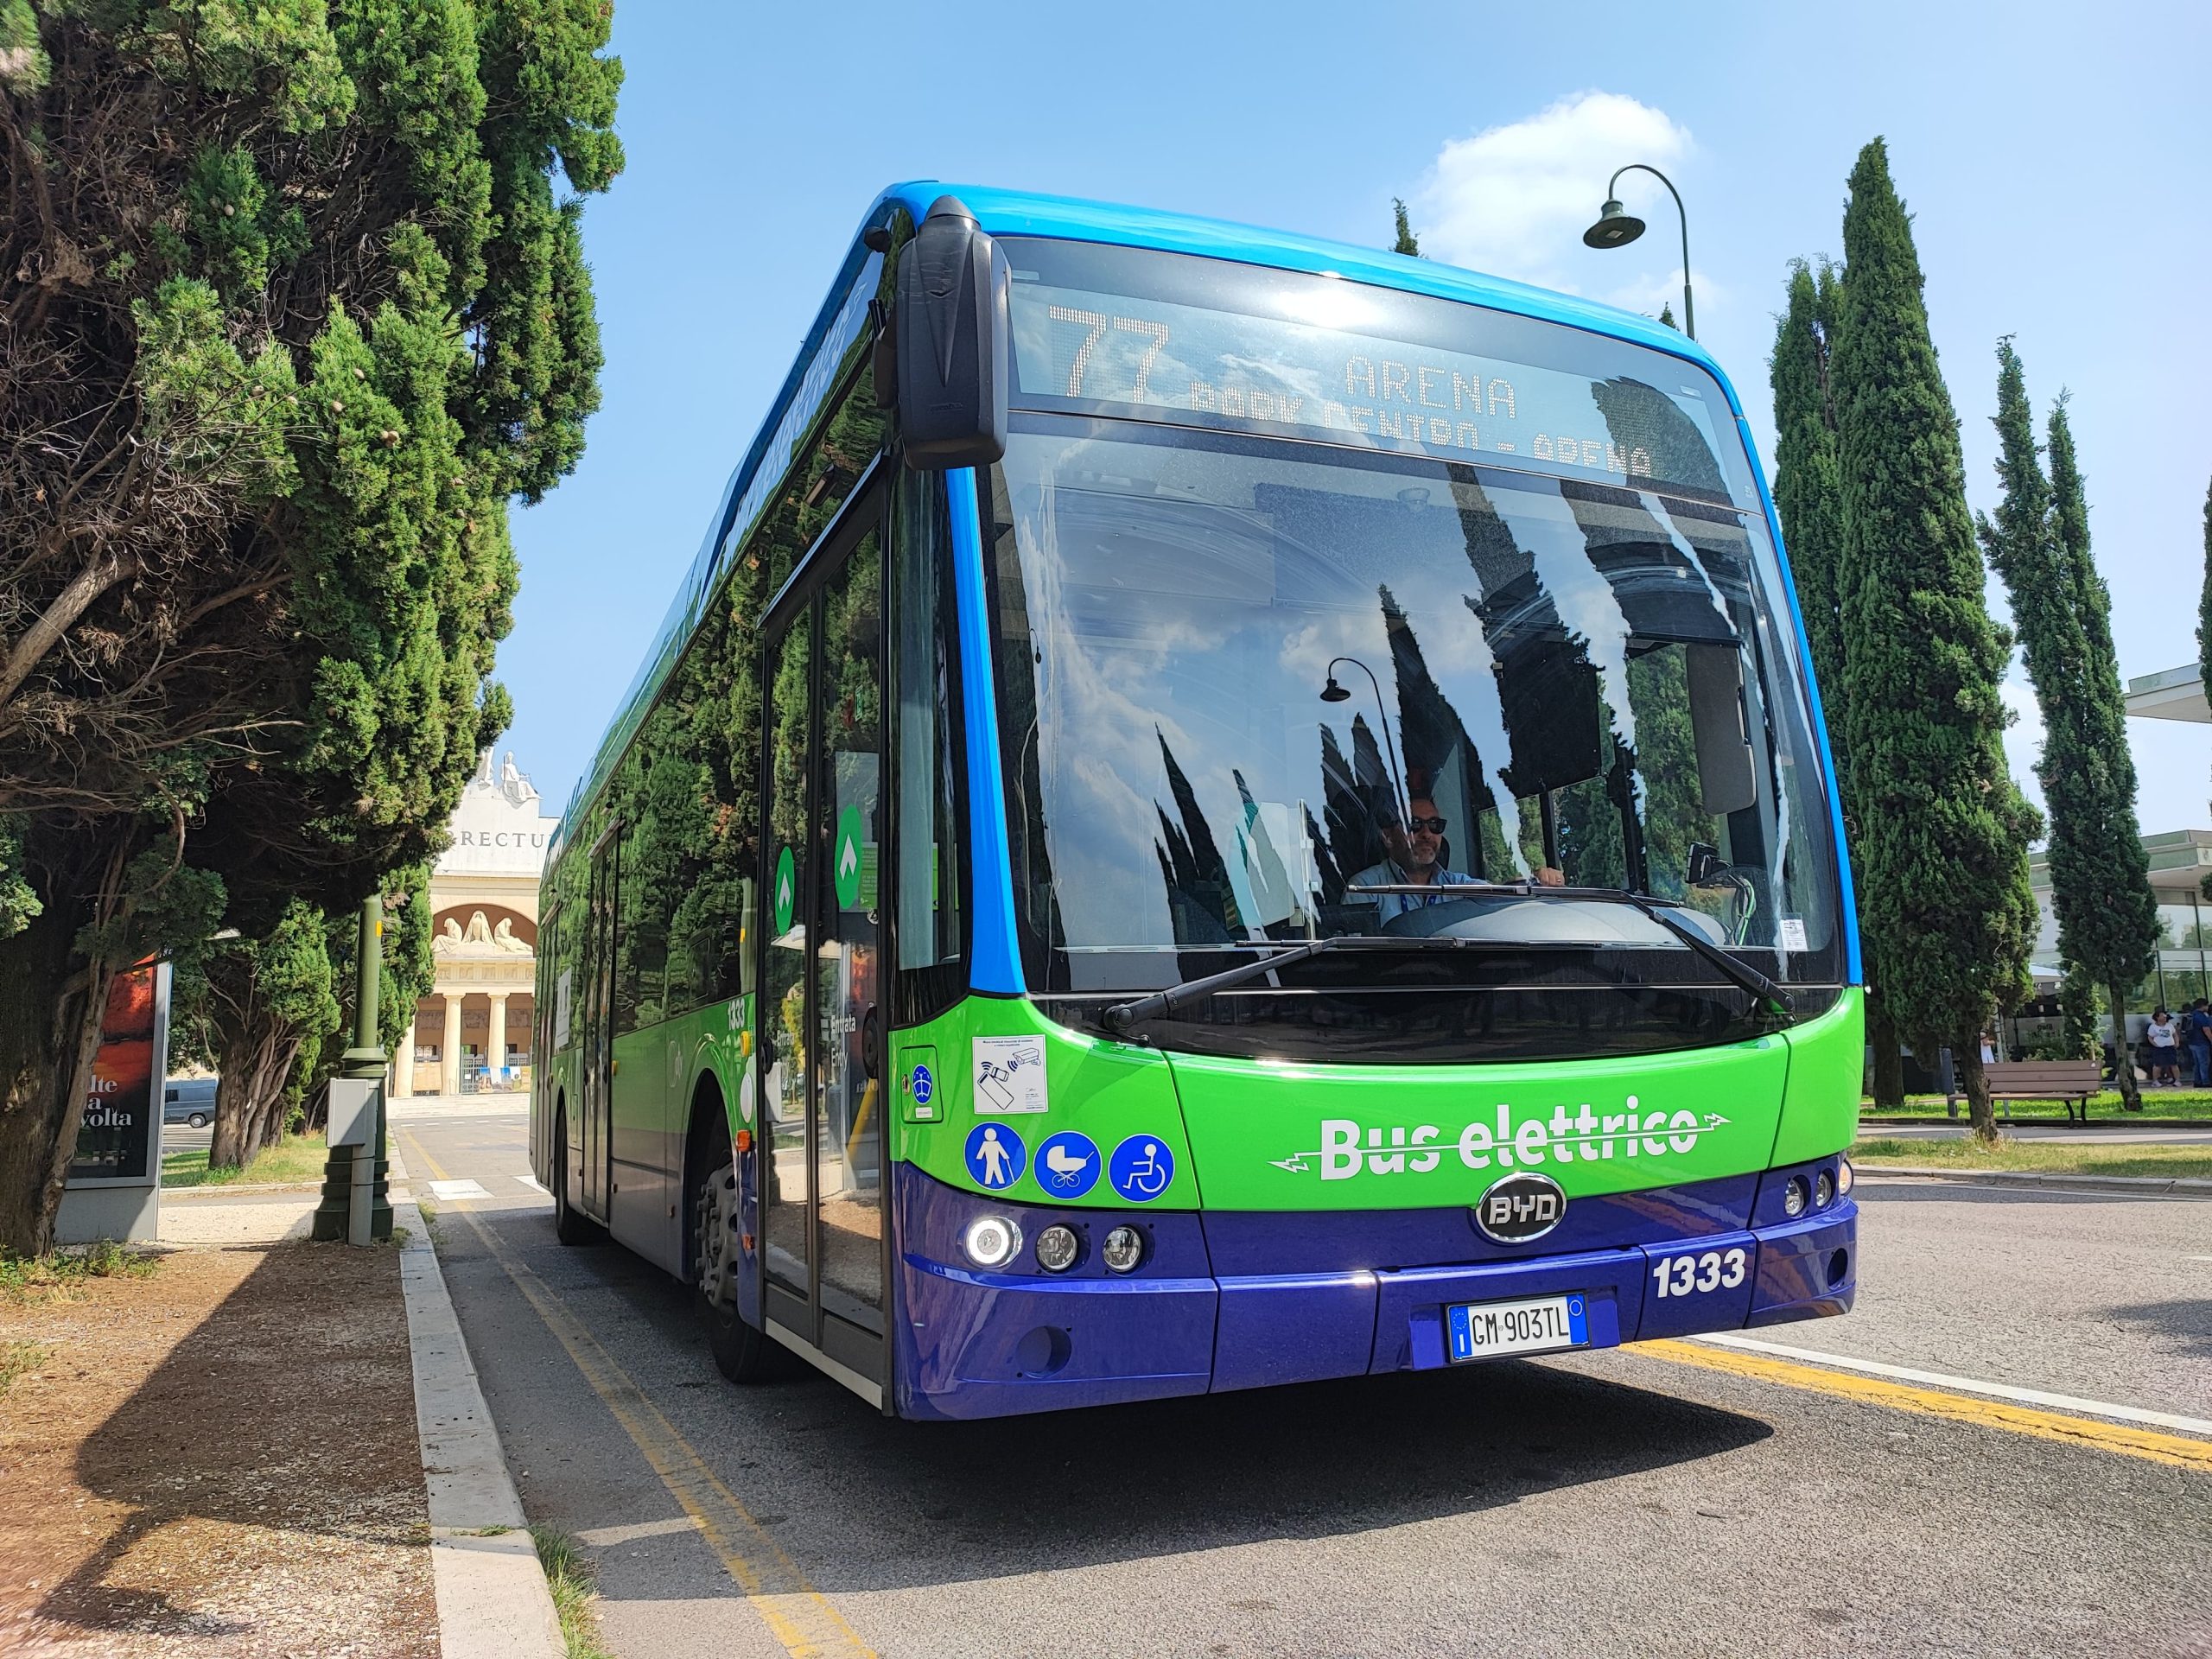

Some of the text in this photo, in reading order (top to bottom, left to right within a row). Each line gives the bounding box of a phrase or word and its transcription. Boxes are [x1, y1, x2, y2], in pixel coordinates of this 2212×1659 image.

[1049, 305, 1169, 404] 77
[1345, 354, 1516, 420] ARENA
[447, 830, 551, 849] RECTU
[728, 998, 746, 1031] 1333
[830, 1013, 856, 1034] Entrata
[830, 1048, 849, 1072] Entry
[89, 1074, 118, 1093] lte
[85, 1096, 102, 1110] a
[80, 1107, 131, 1127] volta
[1320, 1095, 1699, 1181] Bus elettrico
[1489, 1193, 1557, 1224] BYD
[1652, 1248, 1746, 1298] 1333
